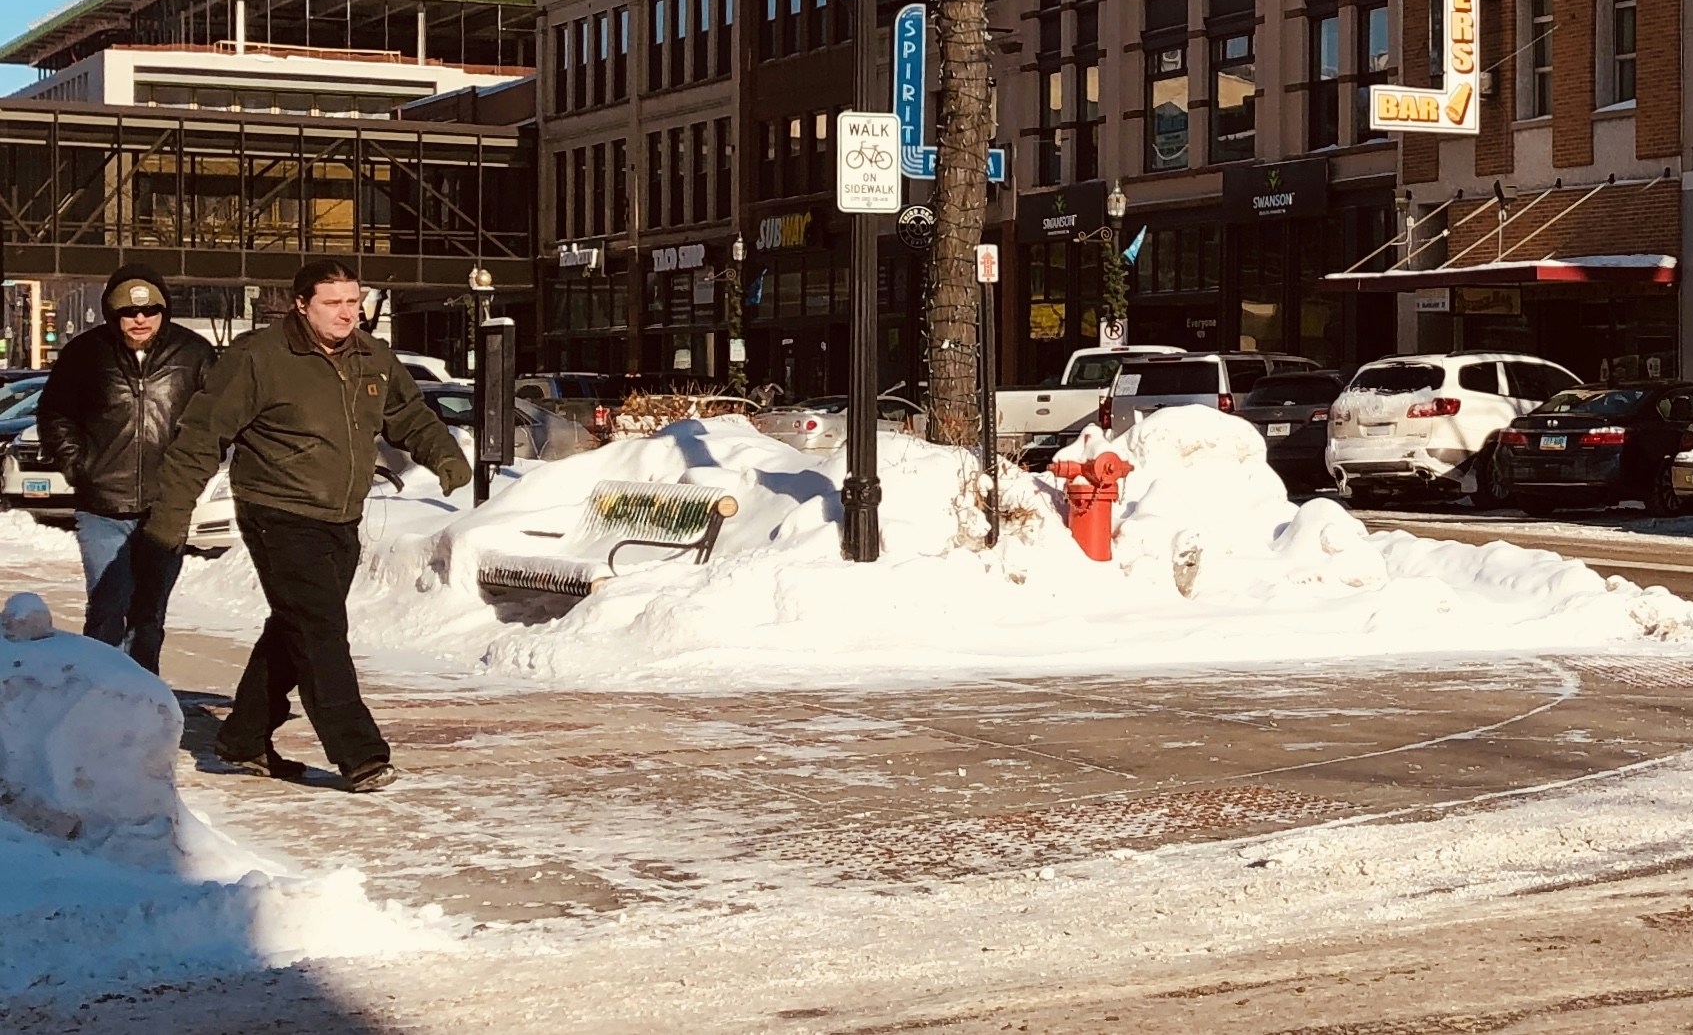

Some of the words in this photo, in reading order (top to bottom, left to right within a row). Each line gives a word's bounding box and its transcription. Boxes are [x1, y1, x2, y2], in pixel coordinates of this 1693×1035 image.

[901, 19, 915, 144] SPIRIT
[1377, 93, 1439, 123] BAR
[849, 123, 889, 137] WALK
[863, 172, 877, 182] ON
[844, 184, 894, 194] SIDEWALK
[1252, 193, 1292, 209] SWANSON
[756, 212, 811, 250] SUBWAY
